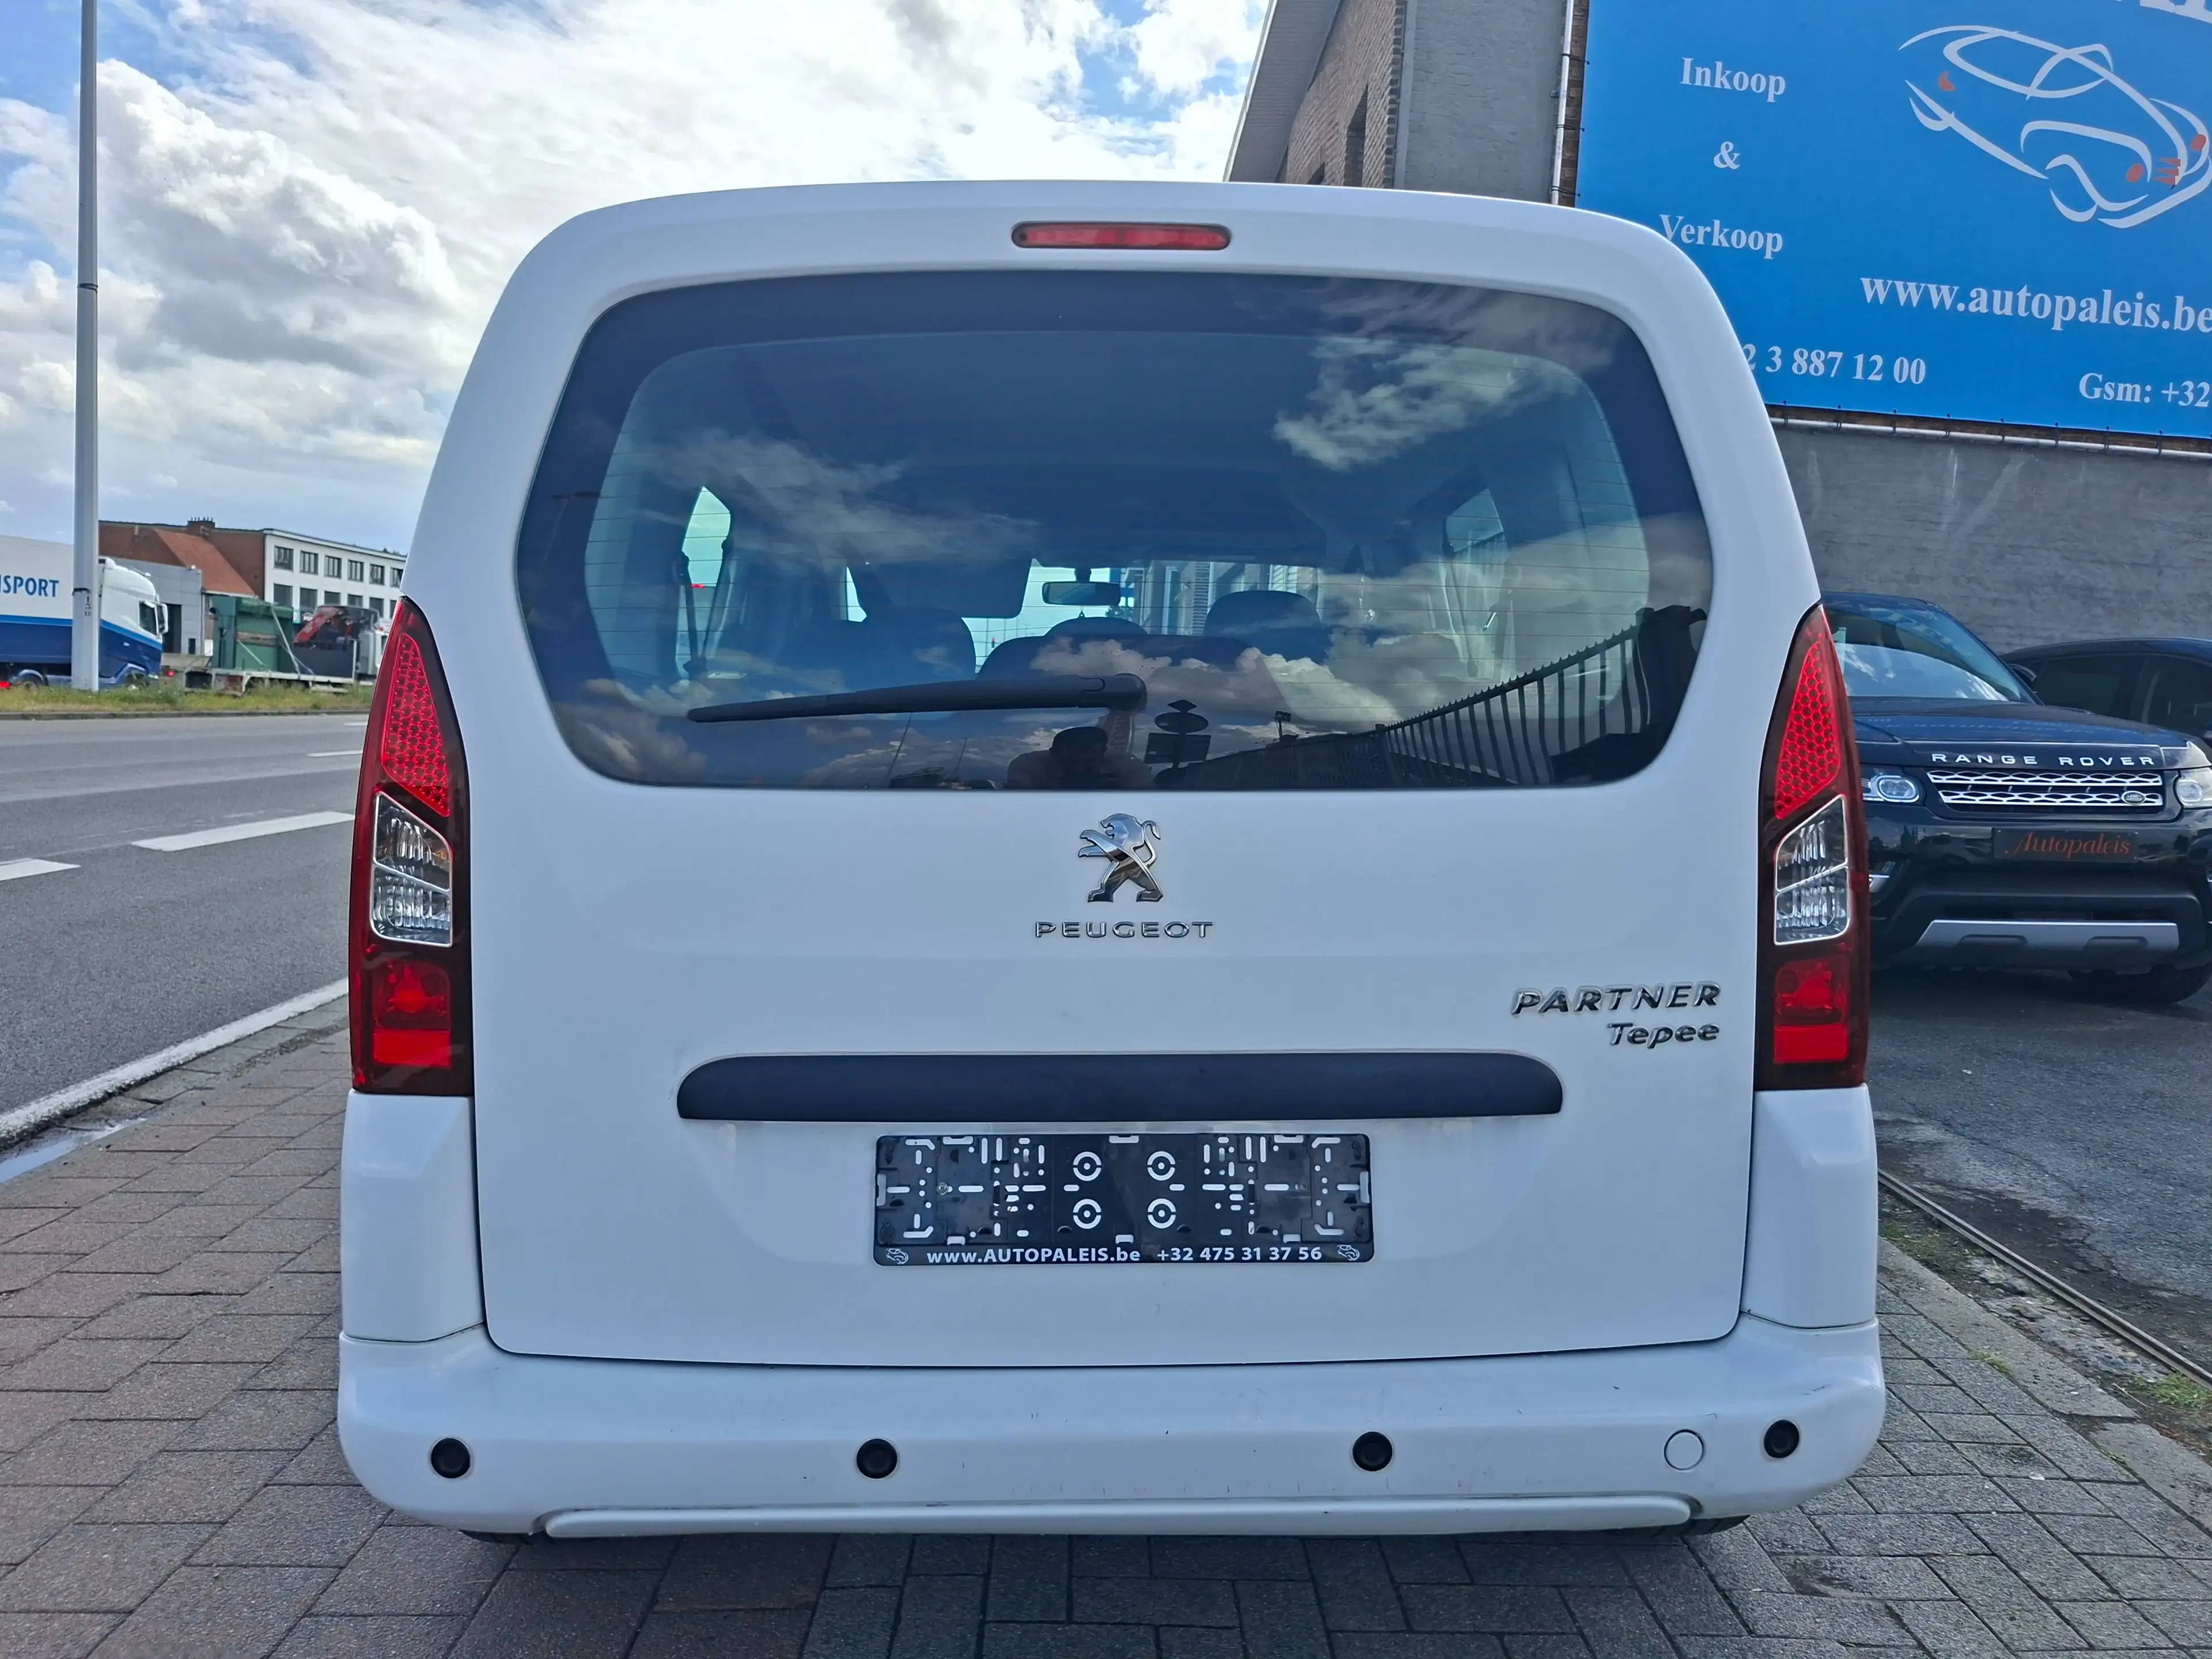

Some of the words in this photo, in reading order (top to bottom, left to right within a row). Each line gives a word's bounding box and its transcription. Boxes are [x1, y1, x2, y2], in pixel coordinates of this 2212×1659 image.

[1679, 57, 1786, 103] Inkoop
[1713, 141, 1741, 169] &
[1659, 214, 1783, 260] Verkoop
[1859, 277, 2212, 333] www.autopaleis.be
[1765, 346, 1782, 372] 3
[1791, 348, 1843, 378] 887
[1852, 353, 1884, 381] 12
[1893, 357, 1926, 385] 00
[2079, 373, 2152, 403] Gsm:
[2161, 380, 2210, 408] +32
[0, 574, 59, 597] SPORT
[1931, 753, 2037, 765] RANGE
[2058, 756, 2155, 767] ROVER
[2005, 832, 2131, 859] Autopaleis
[1035, 921, 1213, 938] PEUGEOT
[1511, 981, 1721, 1015] PARTNER
[1607, 1021, 1720, 1049] Tepee
[926, 1247, 1141, 1263] www.AUTOPALEIS.be
[1157, 1247, 1194, 1261] +32
[1199, 1247, 1235, 1260] 475
[1241, 1247, 1261, 1260] 31
[1269, 1247, 1291, 1260] 37
[1298, 1247, 1323, 1260] 56
